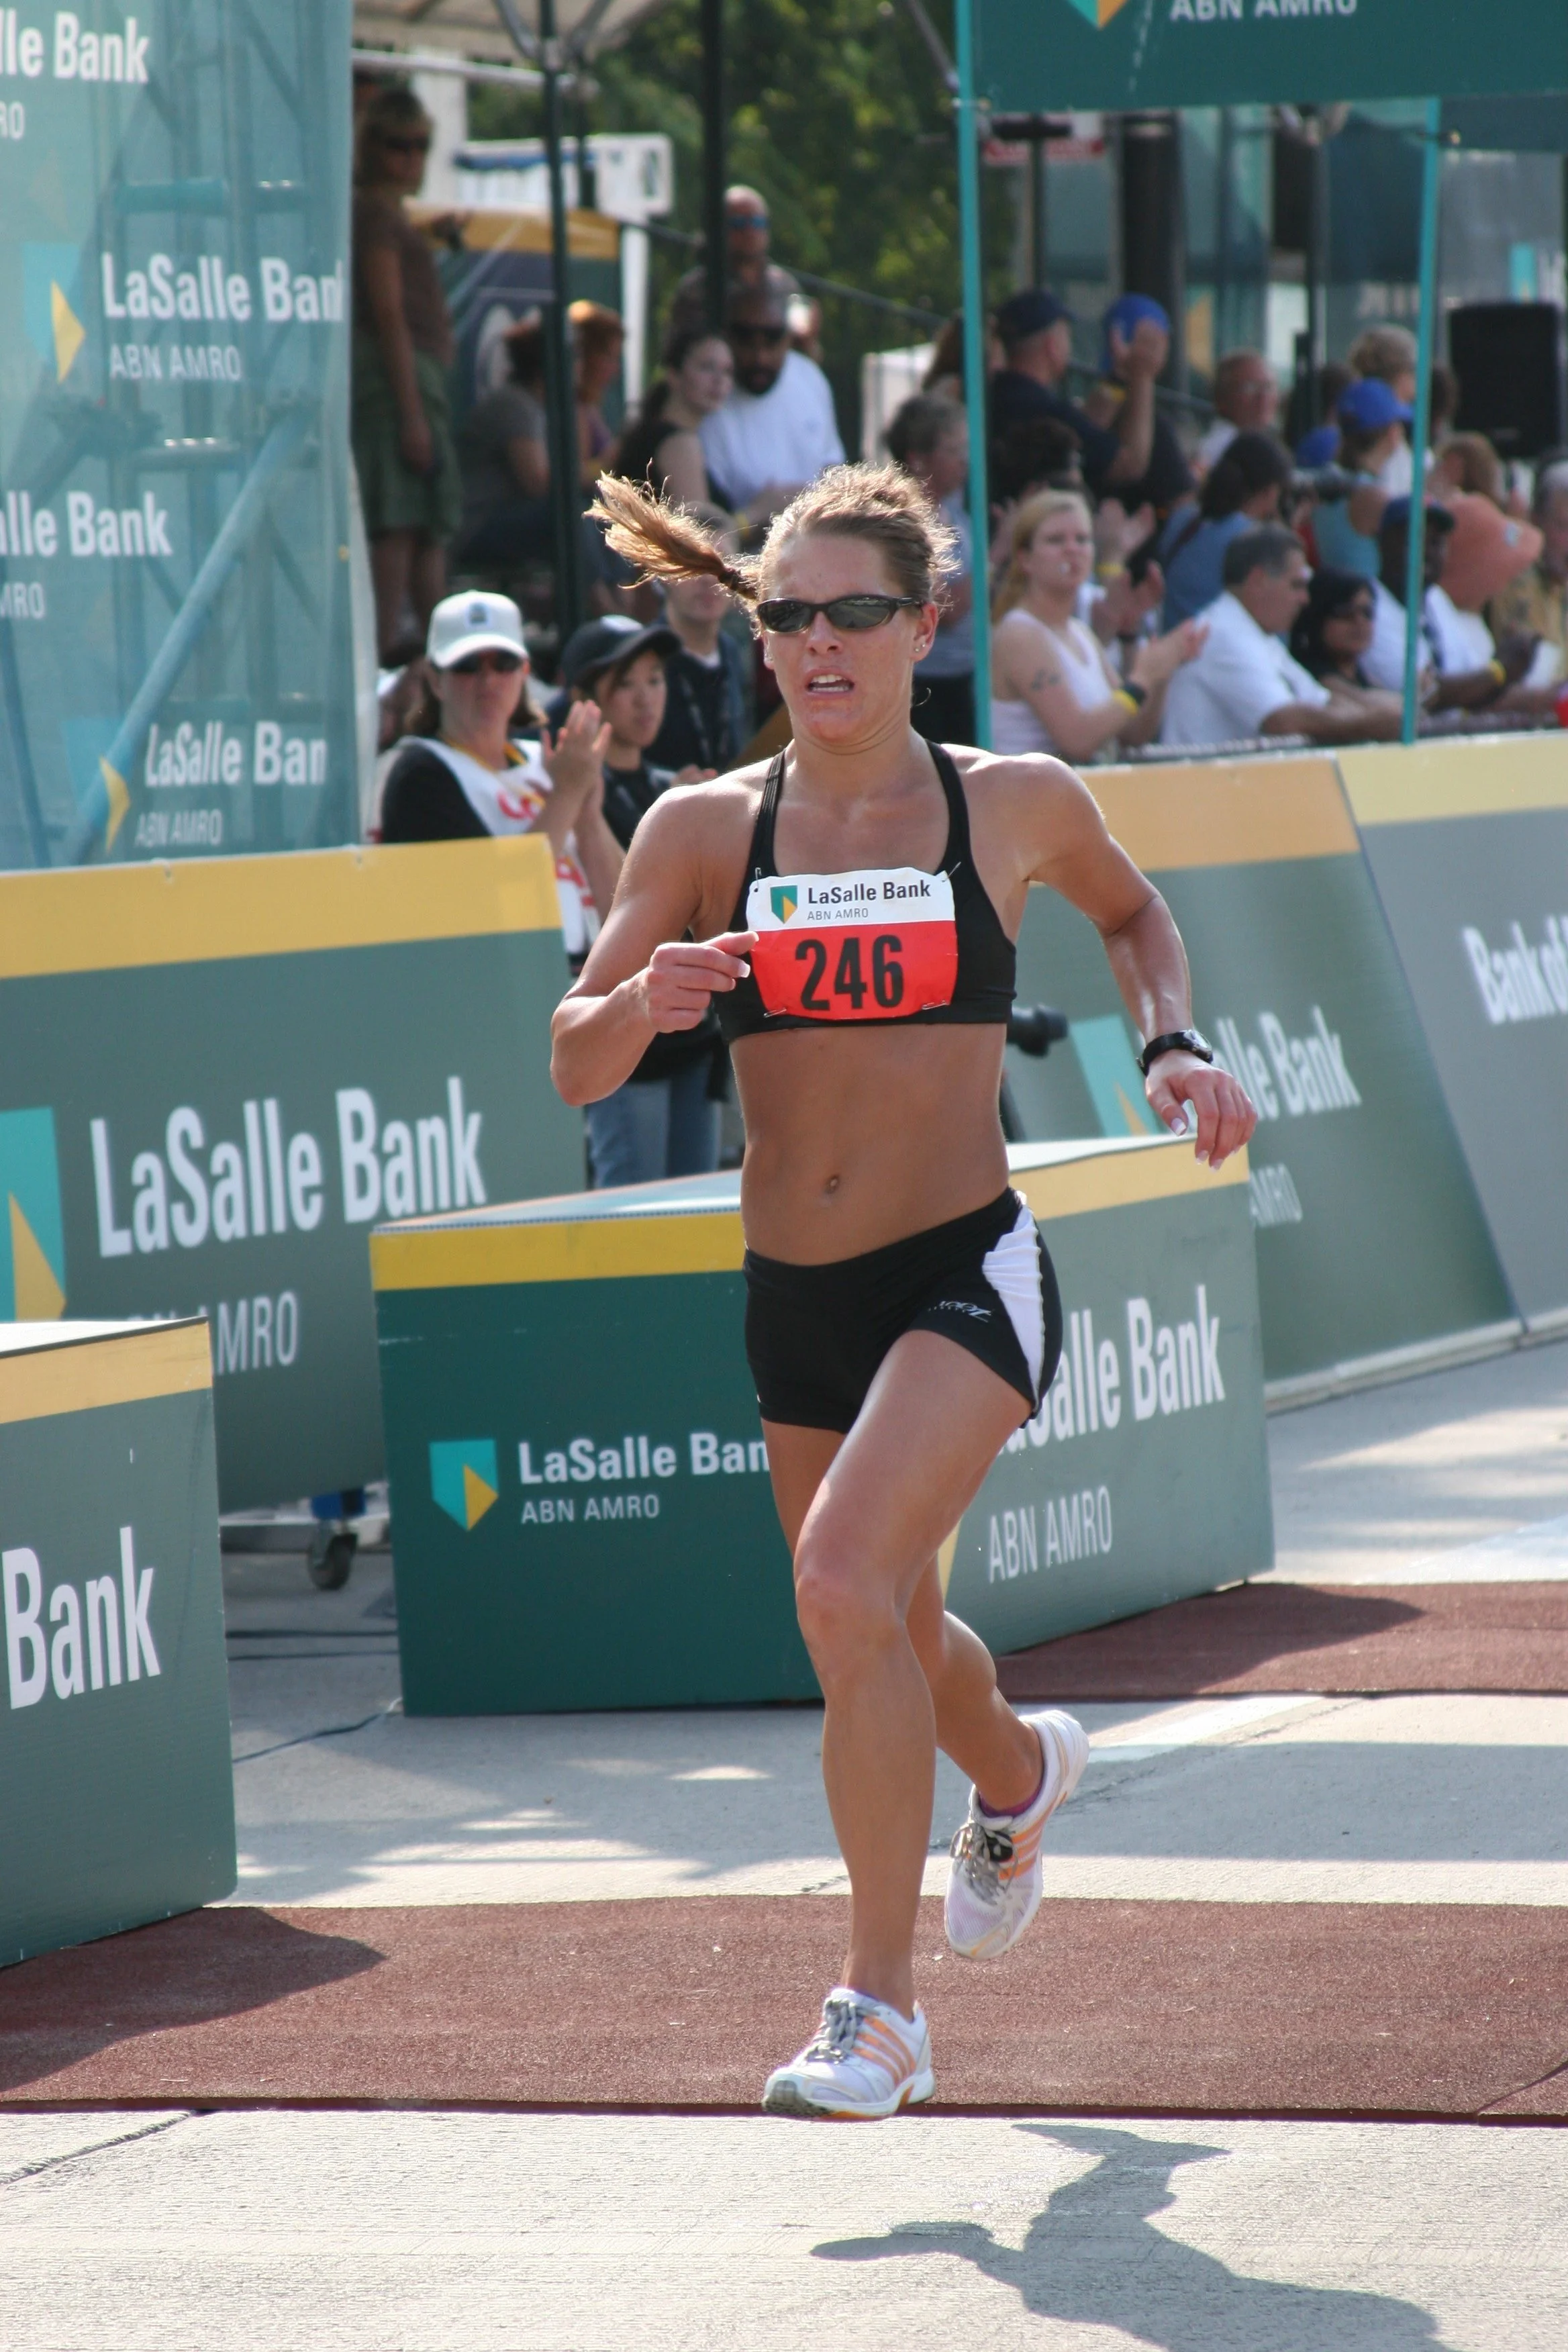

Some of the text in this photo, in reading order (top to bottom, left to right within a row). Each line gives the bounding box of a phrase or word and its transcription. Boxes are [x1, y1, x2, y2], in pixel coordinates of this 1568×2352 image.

[55, 11, 149, 83] Bank
[102, 252, 252, 321] LaSalle
[109, 344, 242, 381] ABN AMRO
[68, 491, 173, 556] Bank
[146, 722, 242, 787] LaSalle
[807, 908, 869, 921] ABN AMRO
[808, 879, 931, 904] LaSalle Bank
[795, 934, 904, 1011] 246
[1462, 920, 1556, 1026] Bank
[1259, 1005, 1361, 1117] Bank
[91, 1076, 487, 1258] LaSalle Bank
[199, 1290, 297, 1375] MRO
[1127, 1284, 1225, 1422] Bank
[518, 1435, 677, 1485] LaSalle
[521, 1494, 660, 1524] ABN AMRO
[989, 1485, 1113, 1583] ABN AMRO
[2, 1526, 161, 1710] Bank
